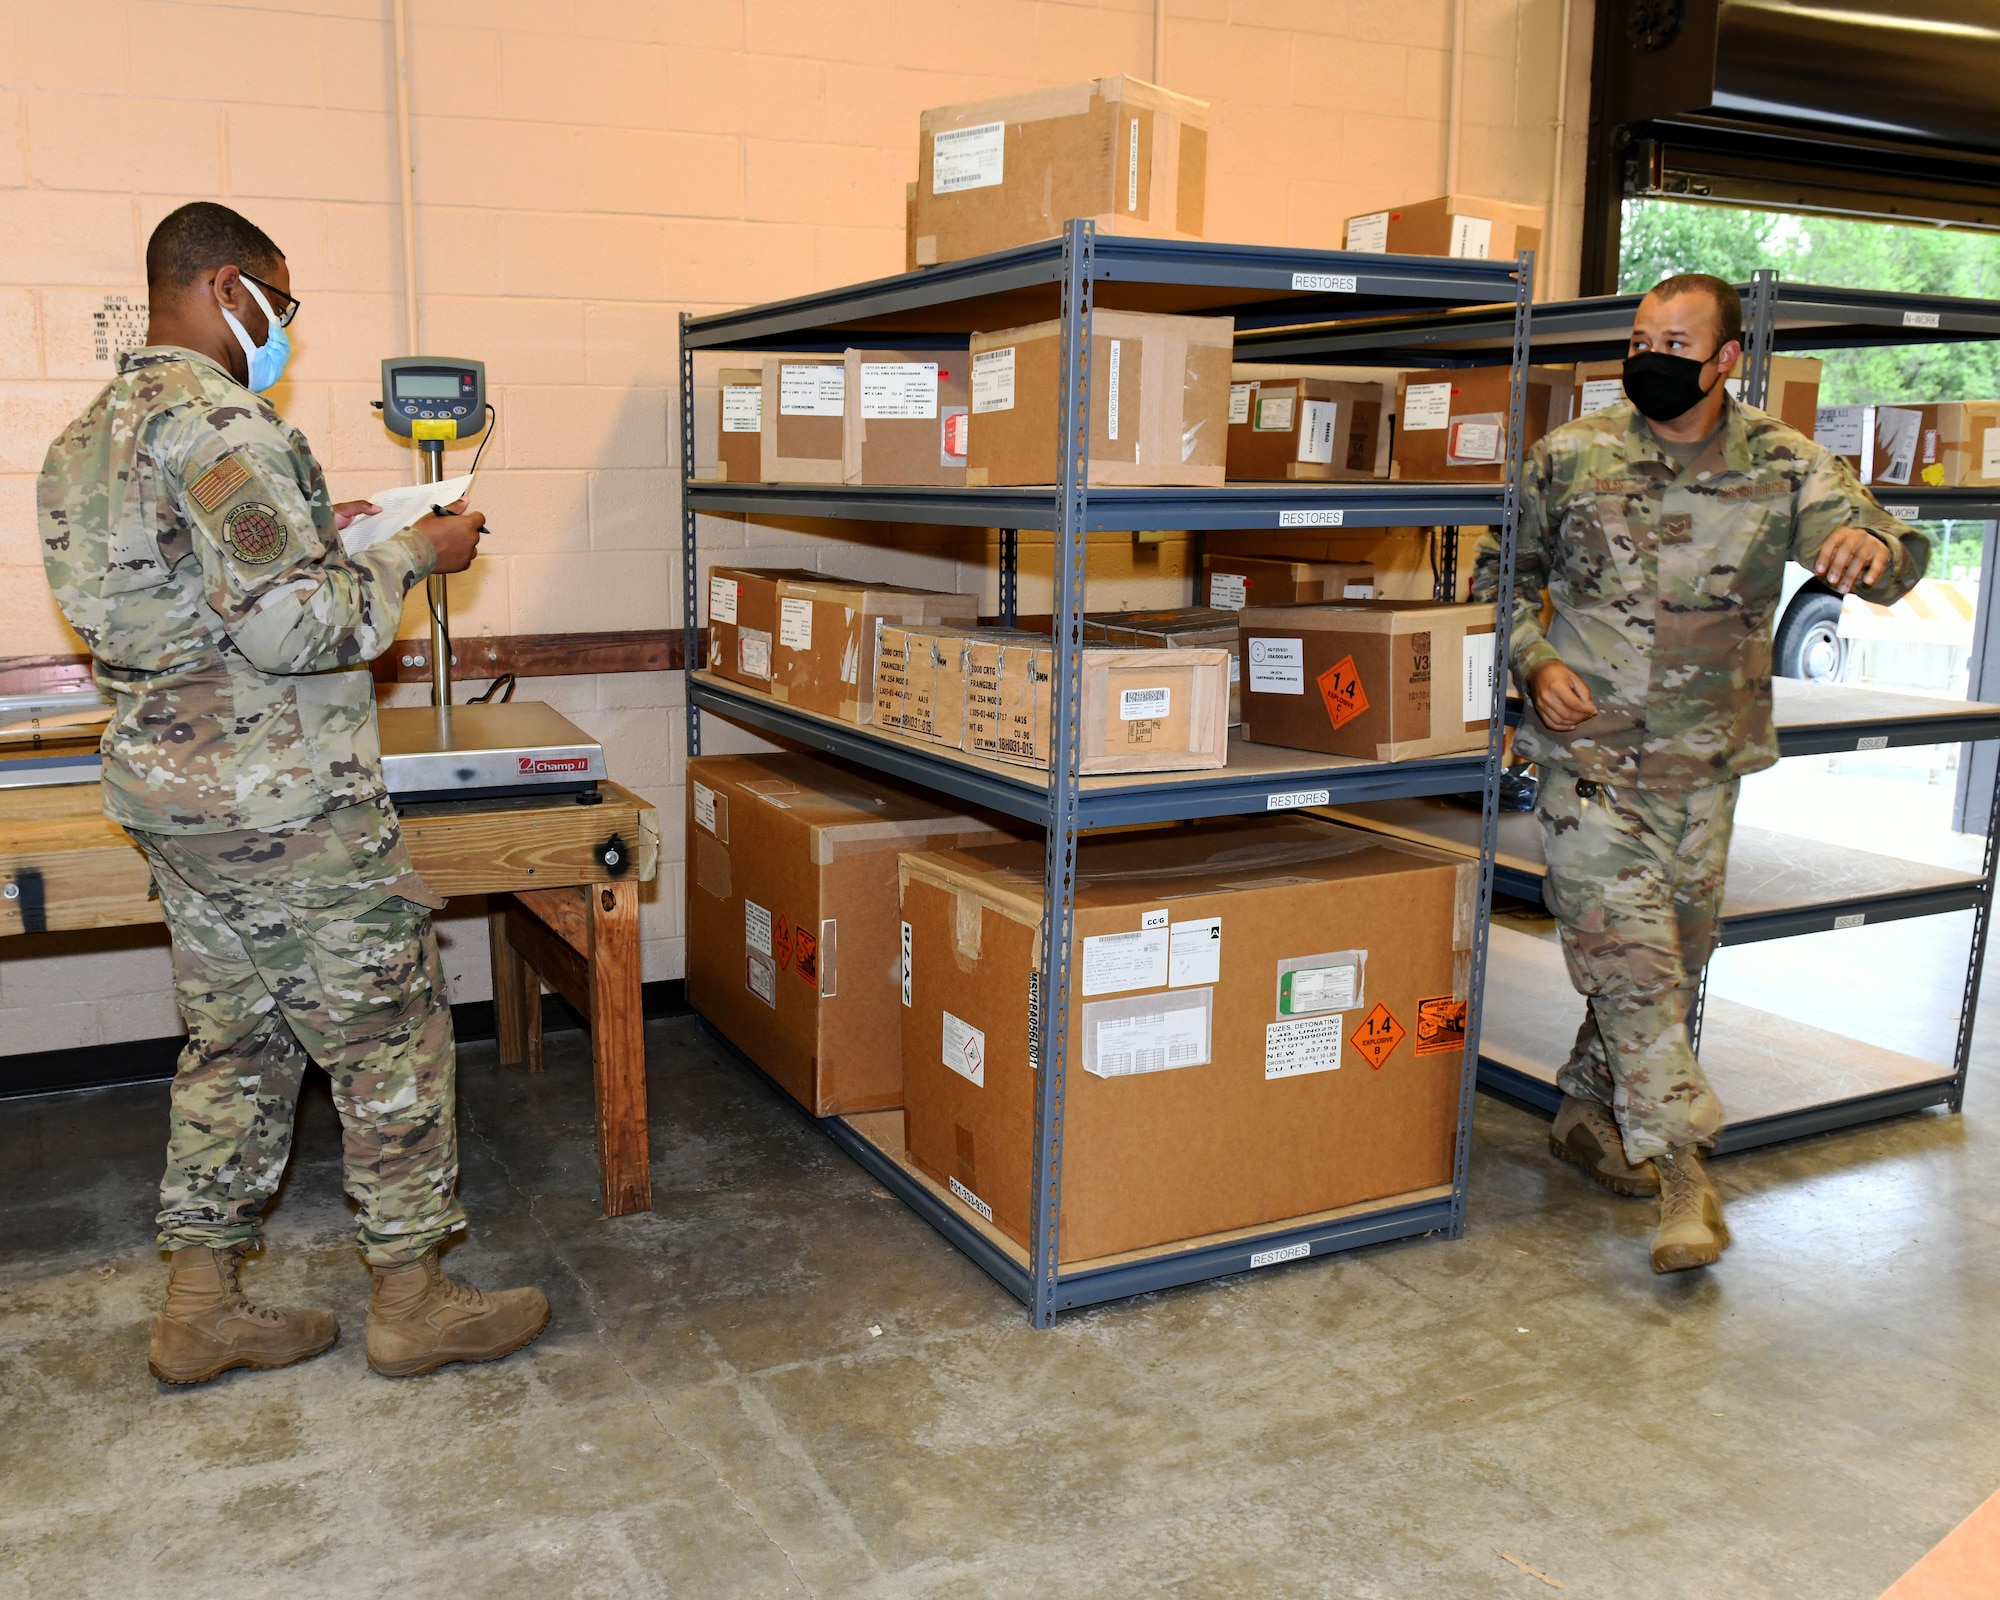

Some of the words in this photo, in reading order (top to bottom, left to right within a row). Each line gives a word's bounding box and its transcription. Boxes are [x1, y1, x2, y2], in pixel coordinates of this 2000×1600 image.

[1295, 275, 1354, 290] RESTORES
[93, 312, 106, 320] HD
[1282, 512, 1340, 524] RESTORES
[893, 649, 904, 659] CRTG
[881, 660, 905, 672] FRANGIBLE
[983, 666, 996, 676] CRTG
[1035, 671, 1048, 683] 9MM
[970, 679, 997, 691] FRANGIBLE
[1333, 672, 1356, 699] 1.4
[918, 695, 929, 704] AA16
[969, 693, 977, 702] MK
[977, 694, 986, 703] 254
[1327, 690, 1355, 710] EXPLOSIVE
[916, 708, 923, 716] CU
[1336, 704, 1342, 712] C
[882, 714, 890, 722] LOT
[1014, 715, 1028, 725] AA16
[968, 723, 976, 731] WT
[977, 724, 984, 733] 65
[1014, 729, 1021, 738] CU
[1022, 731, 1030, 740] .90
[974, 738, 984, 746] LOT
[984, 739, 997, 748] WMA
[536, 762, 576, 772] Champ
[1270, 792, 1327, 808] RESTORES
[1423, 1001, 1440, 1009] CARGO
[1268, 1024, 1294, 1033] FUZES,
[1294, 1018, 1340, 1030] DETONATING
[1298, 1025, 1340, 1035] UN0257
[1367, 1016, 1392, 1036] 1.4
[1268, 1030, 1339, 1045] EX1993090085
[1362, 1036, 1394, 1047] EXPLOSIVE
[1267, 1050, 1297, 1059] N.E.W.
[1305, 1045, 1329, 1054] 237.9
[1374, 1046, 1381, 1055] B
[1267, 1059, 1286, 1067] GROSS
[1315, 1058, 1336, 1066] 11.0
[1253, 1245, 1308, 1265] RESTORES
